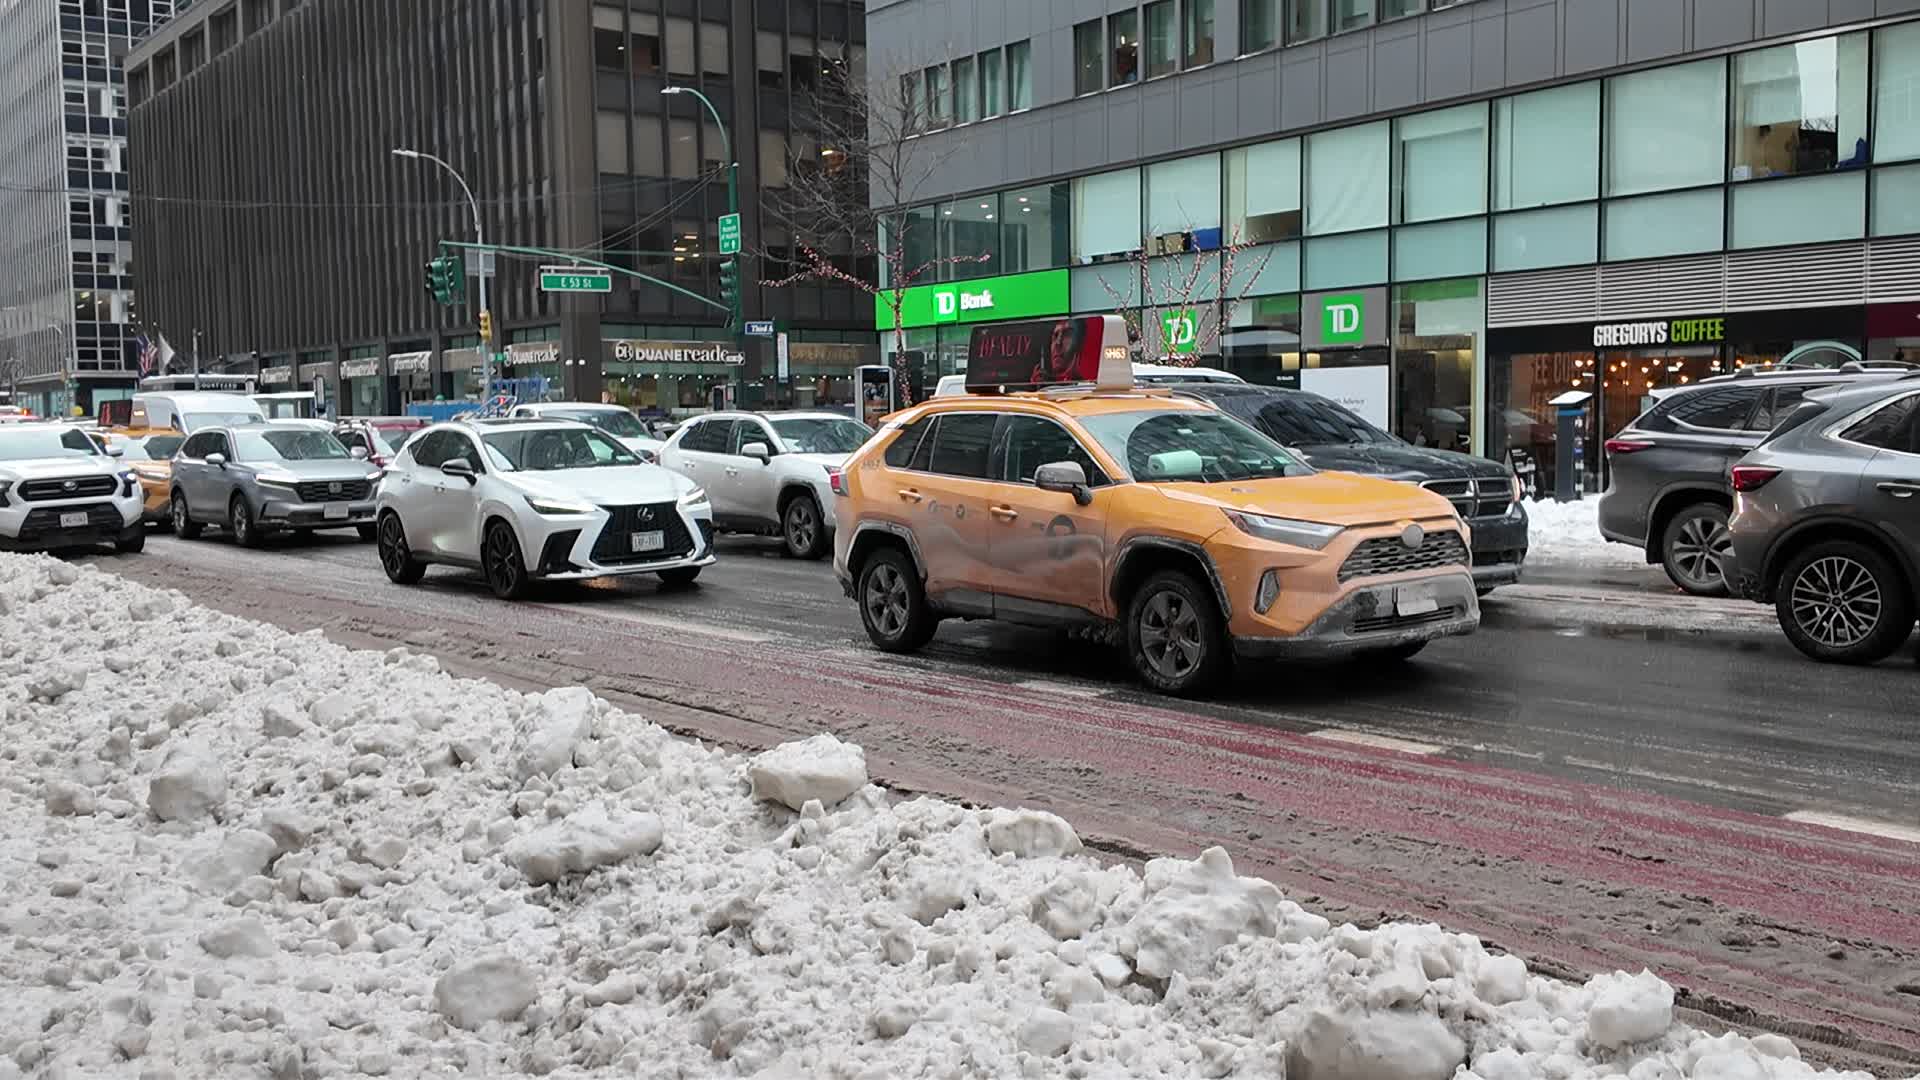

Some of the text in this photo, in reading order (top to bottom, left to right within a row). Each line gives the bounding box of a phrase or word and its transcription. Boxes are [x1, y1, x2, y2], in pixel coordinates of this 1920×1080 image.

[560, 277, 592, 288] E 53 St
[935, 289, 995, 315] TD Bank
[1165, 318, 1193, 345] TD
[1325, 303, 1360, 333] TD
[1593, 318, 1725, 347] GREGORYS COFFEE
